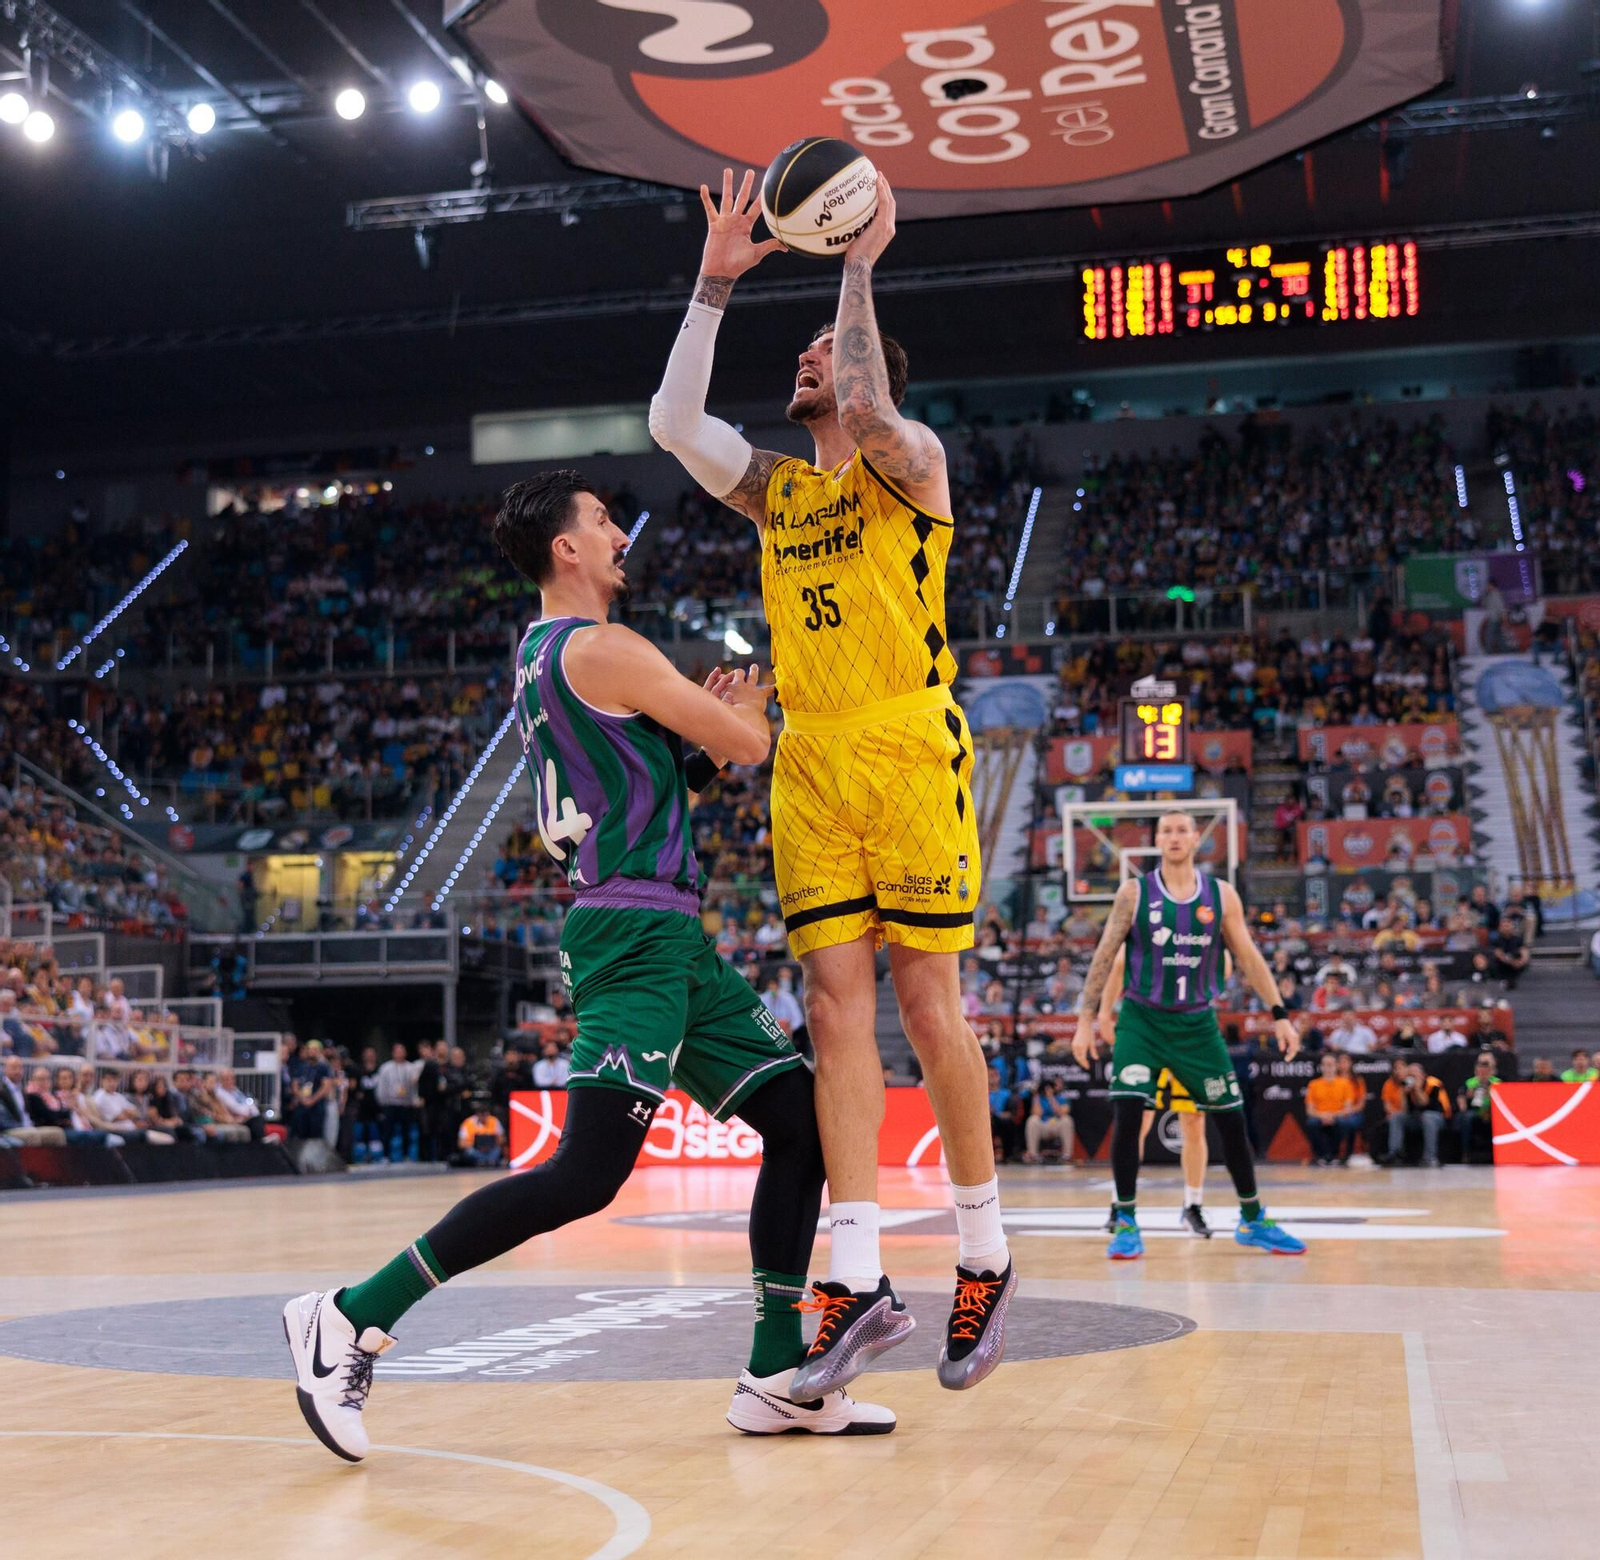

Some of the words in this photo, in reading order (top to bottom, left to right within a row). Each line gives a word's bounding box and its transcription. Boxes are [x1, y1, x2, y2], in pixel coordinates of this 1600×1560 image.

[1040, 0, 1155, 97] Rey
[1175, 4, 1232, 95] Canaria
[821, 77, 914, 147] acb
[903, 25, 1032, 164] copa
[1040, 100, 1115, 146] del
[1197, 93, 1240, 140] Gran
[822, 194, 846, 213] Rey
[845, 188, 858, 200] del
[791, 491, 863, 529] LAGUNA
[802, 582, 842, 631] 35
[1144, 723, 1178, 760] 13
[876, 880, 933, 895] Canarias
[904, 873, 933, 886] Islas
[1176, 975, 1188, 1001] 1
[477, 1349, 600, 1376] BANCO
